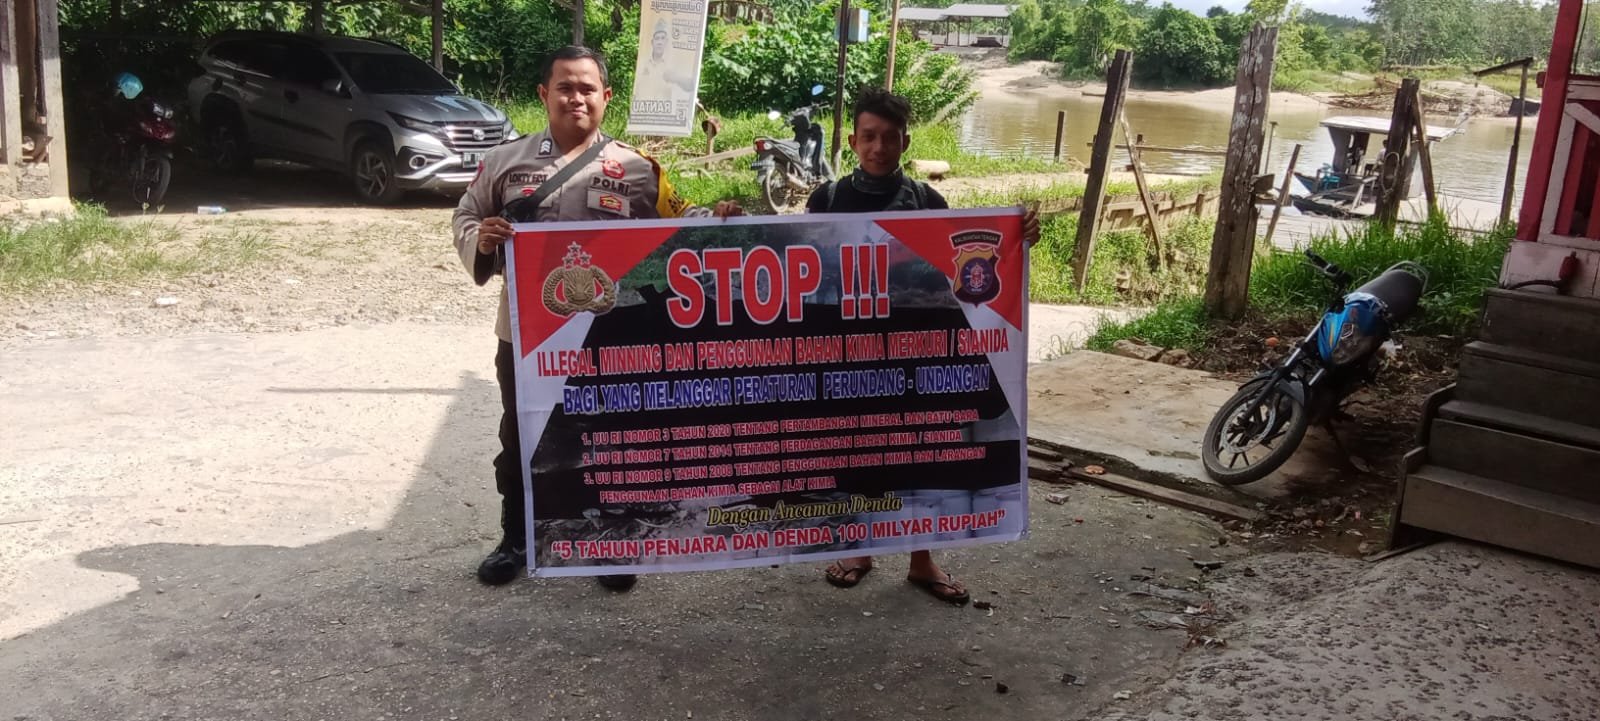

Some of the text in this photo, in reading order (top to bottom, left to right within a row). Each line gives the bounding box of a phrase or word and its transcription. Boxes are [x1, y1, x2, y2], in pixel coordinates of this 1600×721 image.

[593, 176, 631, 197] POLRI
[666, 243, 890, 328] STOP !!!
[537, 328, 1009, 377] ILLEGAL MINNING DAN PENGGUNAAN BAHAN KIMIA MERKURI / SIANIDA
[563, 363, 990, 415] BAGI YANG MELANGGAR PERATURAN PERUNDANG - UNDANGAN
[581, 409, 979, 446] 1. UU RI NOMOR 3 TAHUN 2020 TENTANG PERTAMBANGAN MINERAL DAN BATU BARA
[583, 429, 963, 465] 2. UU RI NOMOR 7 TAHUN 2014 TENTANG PERDAGANGAN BAHAN KIMIA / SIANIDA
[584, 472, 594, 485] 3.
[595, 471, 612, 485] UU
[612, 470, 625, 485] RI
[625, 468, 663, 484] NOMOR
[664, 468, 672, 481] 9
[673, 465, 708, 481] TAHUN
[734, 460, 781, 477] TENTANG
[781, 455, 849, 473] PENGGUNAAN
[850, 453, 883, 467] BAHAN
[884, 451, 913, 465] KIMIA
[913, 449, 934, 463] DAN
[935, 447, 986, 462] LARANGAN
[600, 476, 837, 504] PENGGUNAAN BAHAN KIMIA SEBAGAI ALAT KIMIA
[706, 491, 903, 528] Dengan Ancaman Denda
[575, 540, 640, 559] TAHUN
[643, 535, 728, 557] PENJARA
[732, 531, 769, 551] DAN
[773, 527, 833, 548] DENDA
[837, 524, 868, 543] 100
[872, 518, 933, 540] MILYAR
